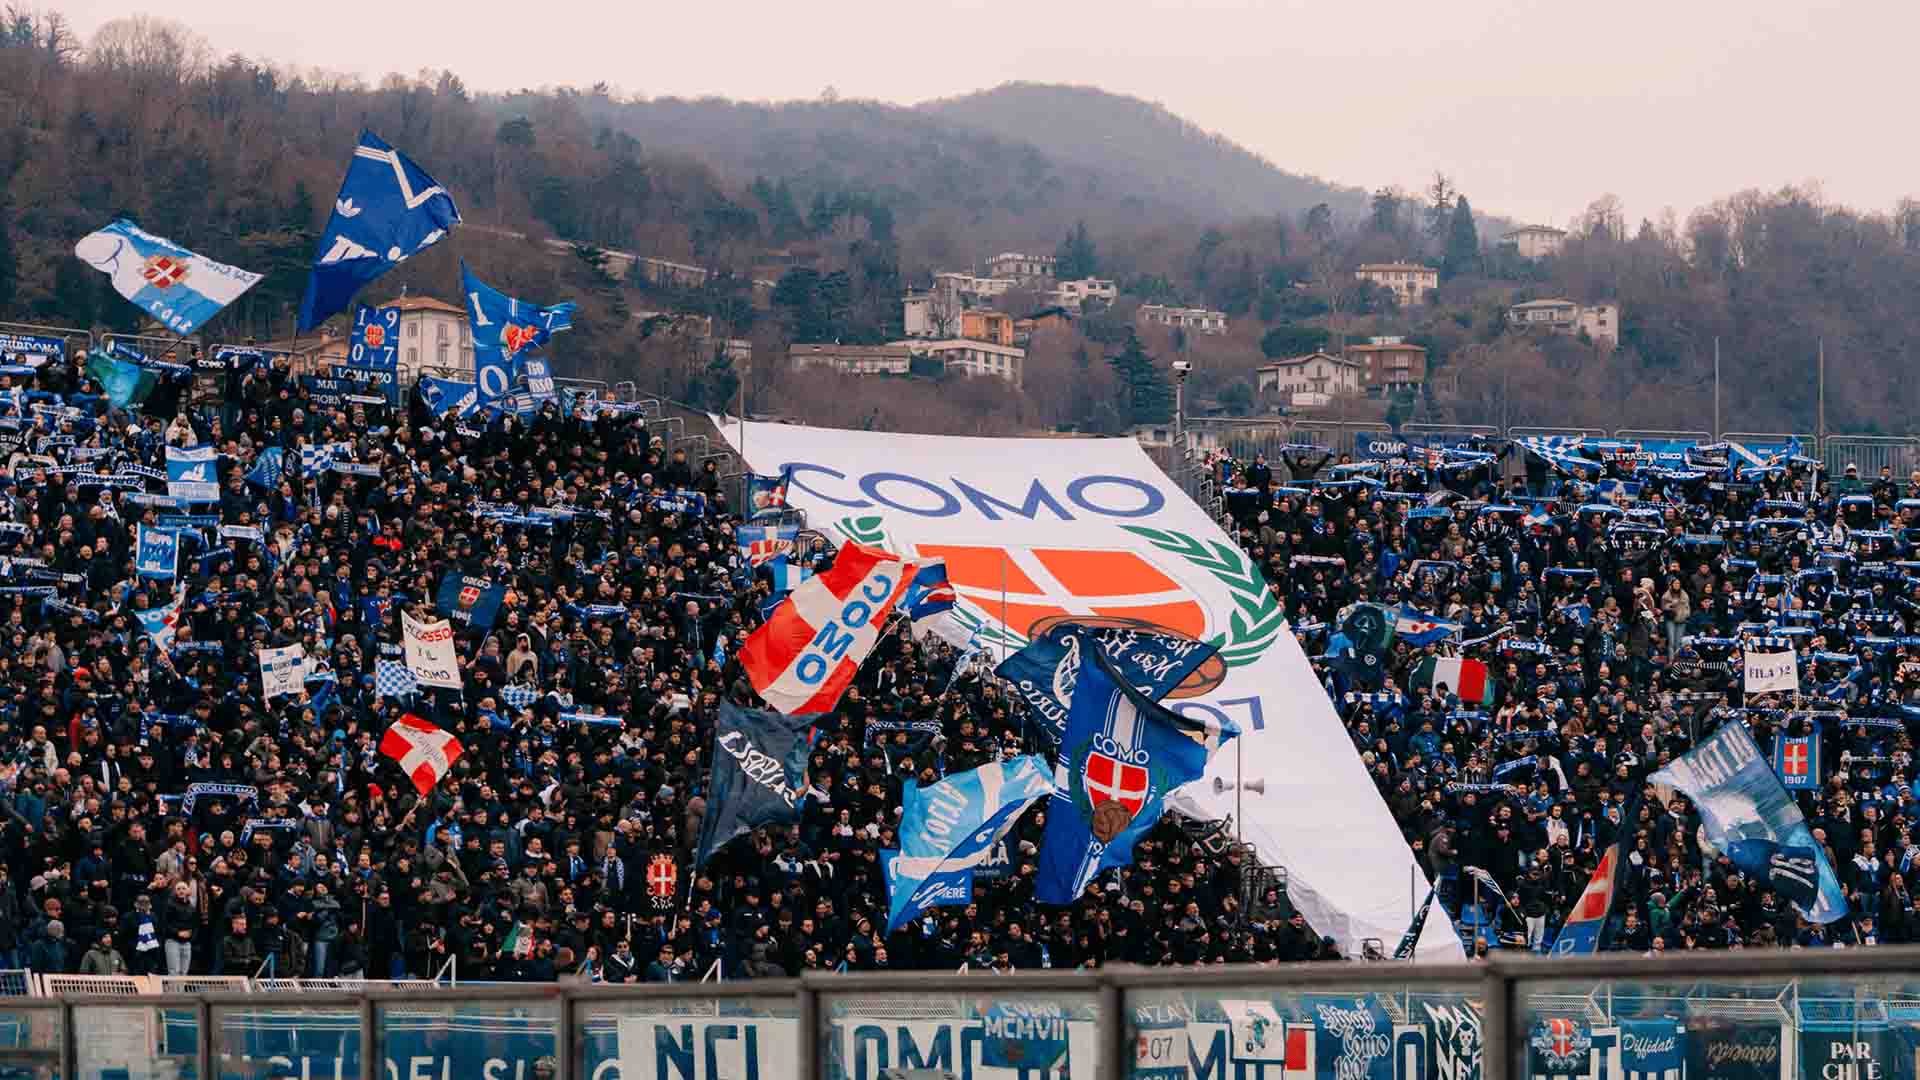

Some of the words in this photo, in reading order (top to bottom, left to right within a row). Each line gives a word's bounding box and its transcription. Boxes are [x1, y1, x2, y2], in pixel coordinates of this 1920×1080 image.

[358, 308, 367, 326] 1
[385, 311, 397, 328] 9
[383, 346, 395, 364] 7
[778, 462, 1165, 521] COMO
[416, 666, 450, 680] COMO
[1092, 732, 1150, 764] COMO
[1784, 776, 1808, 785] 1907
[985, 1018, 1064, 1043] MCMVII
[1623, 1033, 1675, 1063] Diffidati
[1831, 1042, 1871, 1060] PAR
